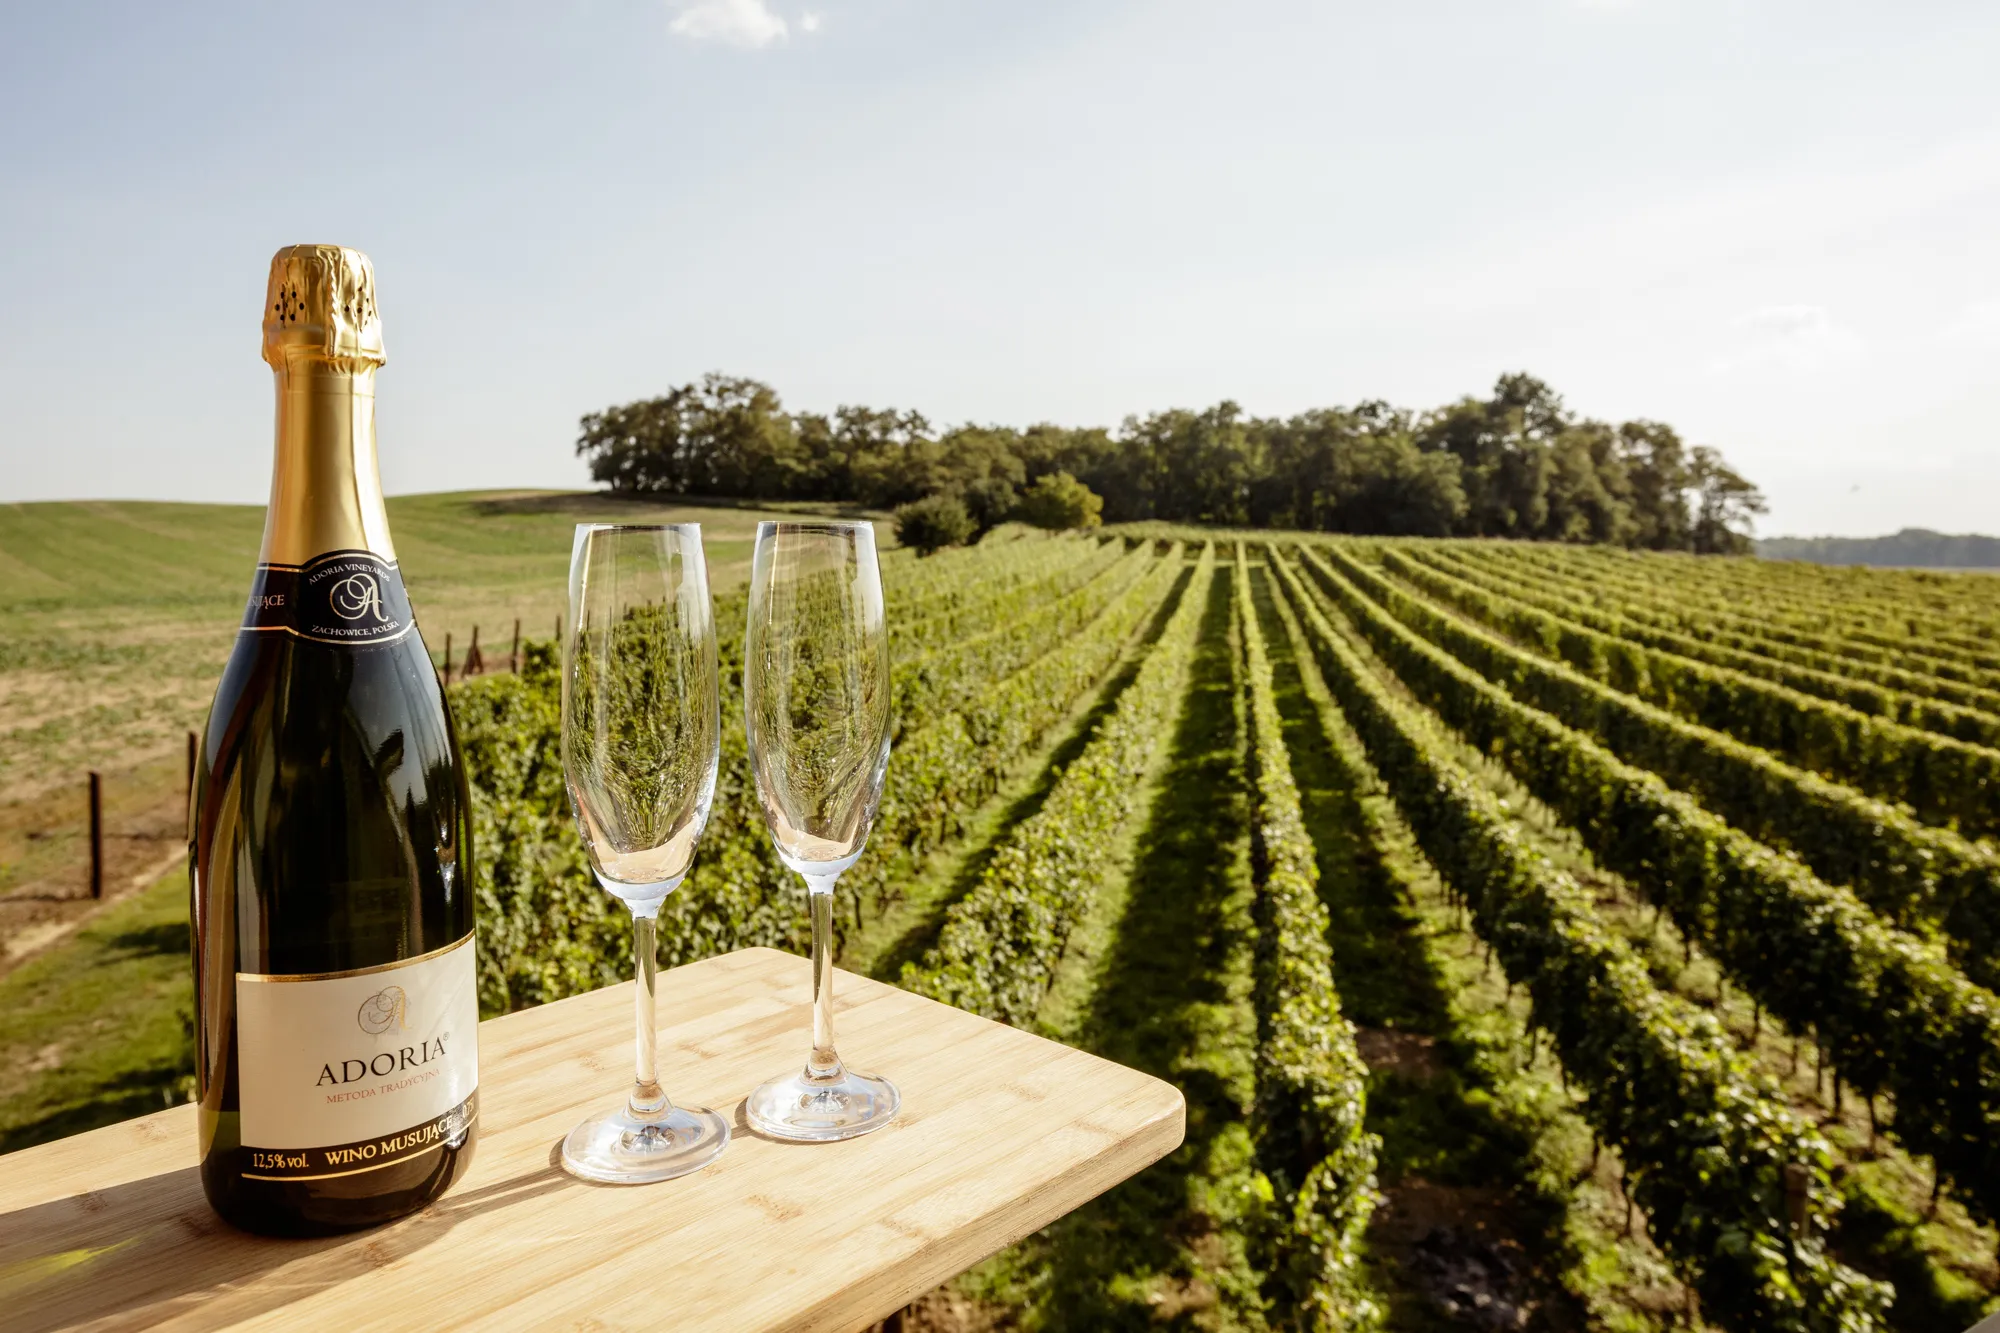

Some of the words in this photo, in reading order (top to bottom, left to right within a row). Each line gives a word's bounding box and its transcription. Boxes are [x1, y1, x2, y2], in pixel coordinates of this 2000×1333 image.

[309, 566, 344, 585] ADORIA
[345, 563, 391, 582] VINEYARDS
[372, 620, 400, 635] POLSKA
[326, 1088, 376, 1104] METODA
[379, 1068, 441, 1095] TRADYCYJNA
[253, 1152, 285, 1169] 12,5%
[287, 1152, 310, 1168] vol.
[325, 1144, 377, 1165] WINO
[381, 1115, 454, 1156] MUSUJĄCE
